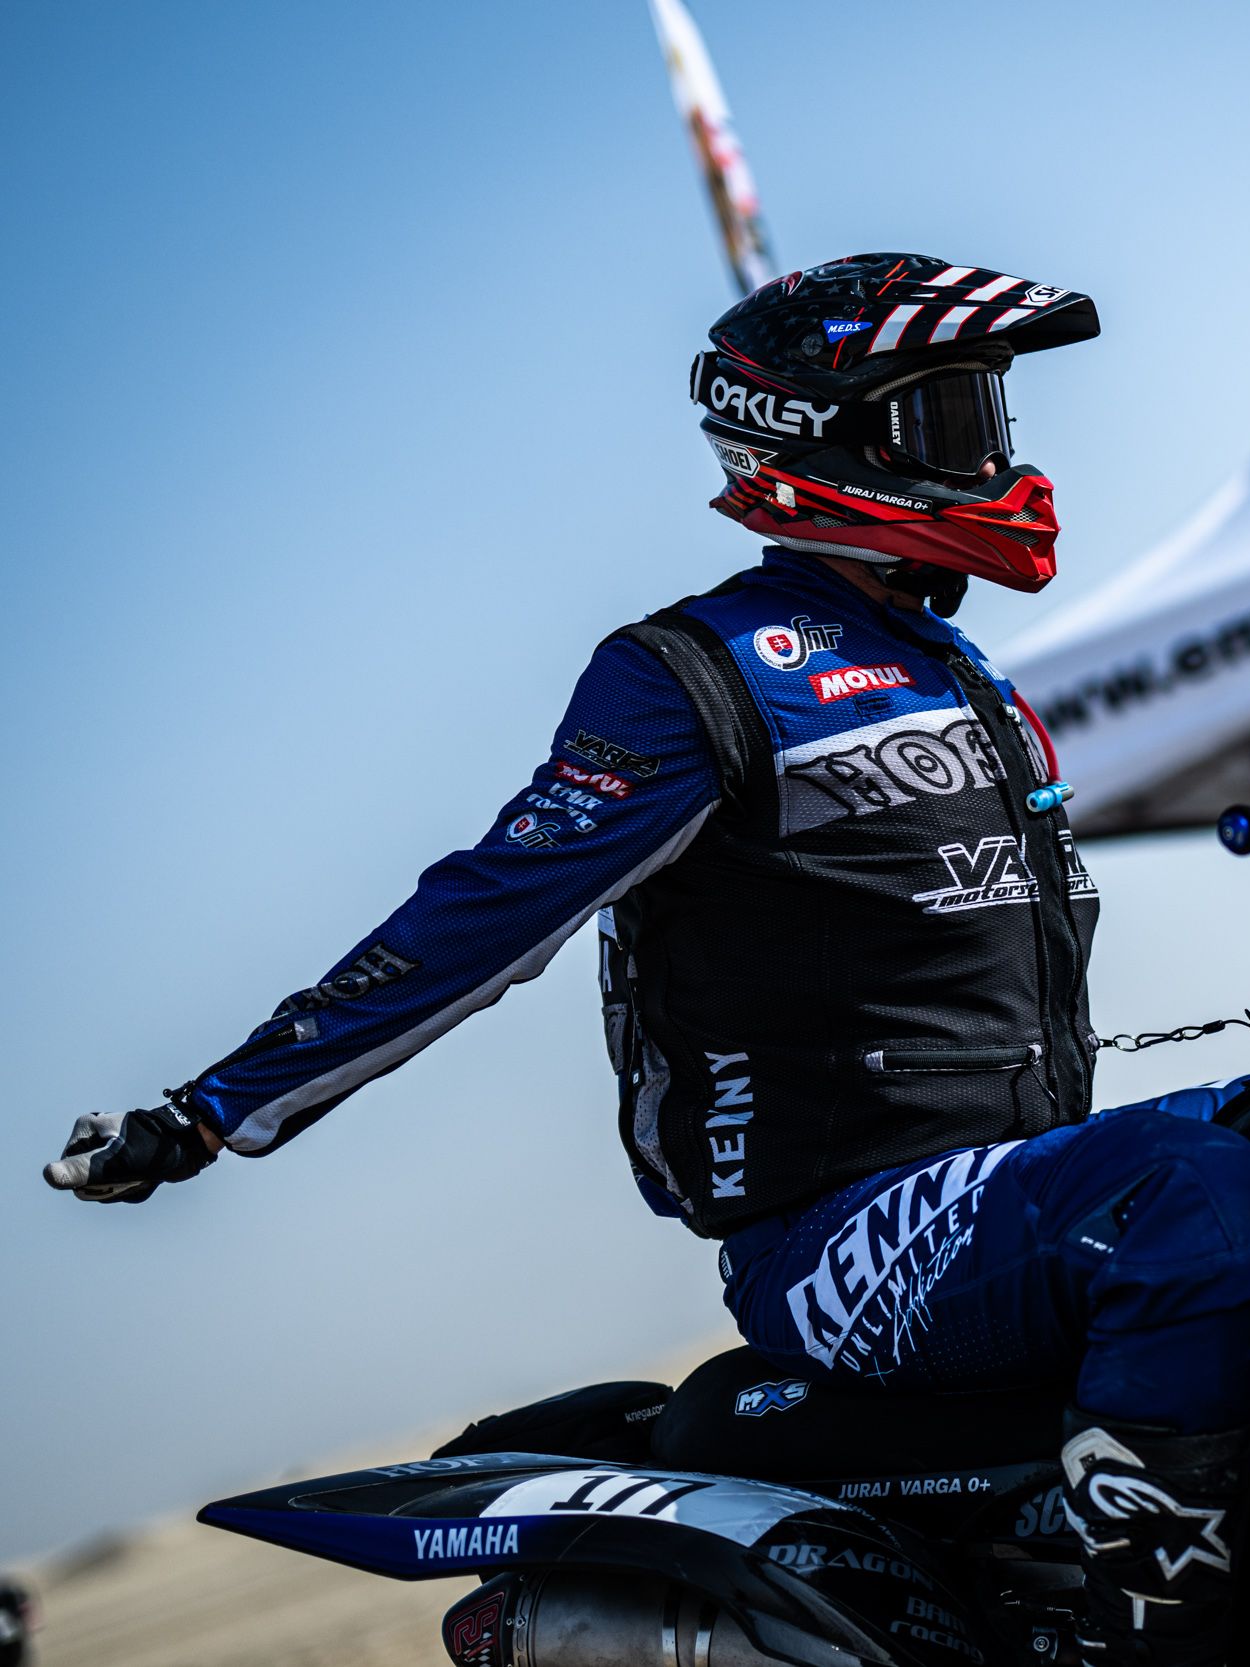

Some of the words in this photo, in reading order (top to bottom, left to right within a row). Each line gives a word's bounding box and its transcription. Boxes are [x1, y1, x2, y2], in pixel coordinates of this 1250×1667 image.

[827, 320, 862, 335] M.E.D.S.
[710, 375, 839, 437] OAKLEY
[889, 401, 901, 445] OAKLEY
[714, 442, 752, 472] SHOEI
[842, 484, 874, 499] JURAJ
[876, 490, 913, 509] VARGA
[820, 665, 911, 700] MOTUL
[703, 1050, 754, 1199] KENNY
[737, 1380, 808, 1414] MXS
[550, 1474, 716, 1516] 177
[838, 1480, 890, 1499] JURAJ
[900, 1477, 962, 1496] VARGA
[968, 1476, 991, 1494] 0+
[1014, 1485, 1067, 1538] SC
[413, 1523, 519, 1560] YAMAHA
[766, 1544, 935, 1593] DRAGON
